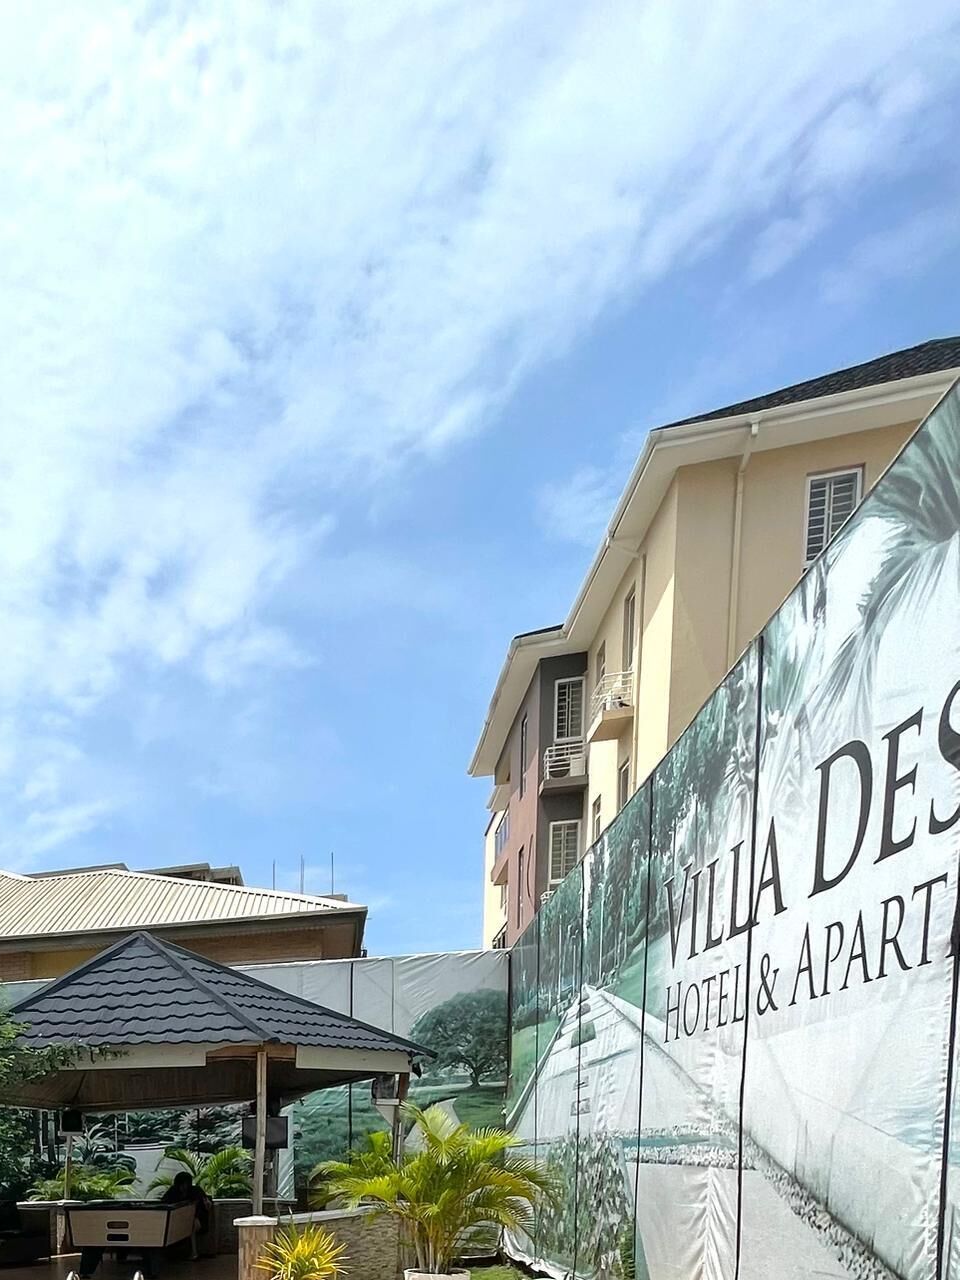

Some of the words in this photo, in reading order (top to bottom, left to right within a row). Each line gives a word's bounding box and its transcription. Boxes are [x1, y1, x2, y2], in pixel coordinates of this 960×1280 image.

[664, 816, 787, 969] VILLA
[664, 964, 745, 1043] HOTEL
[756, 953, 779, 1016] &
